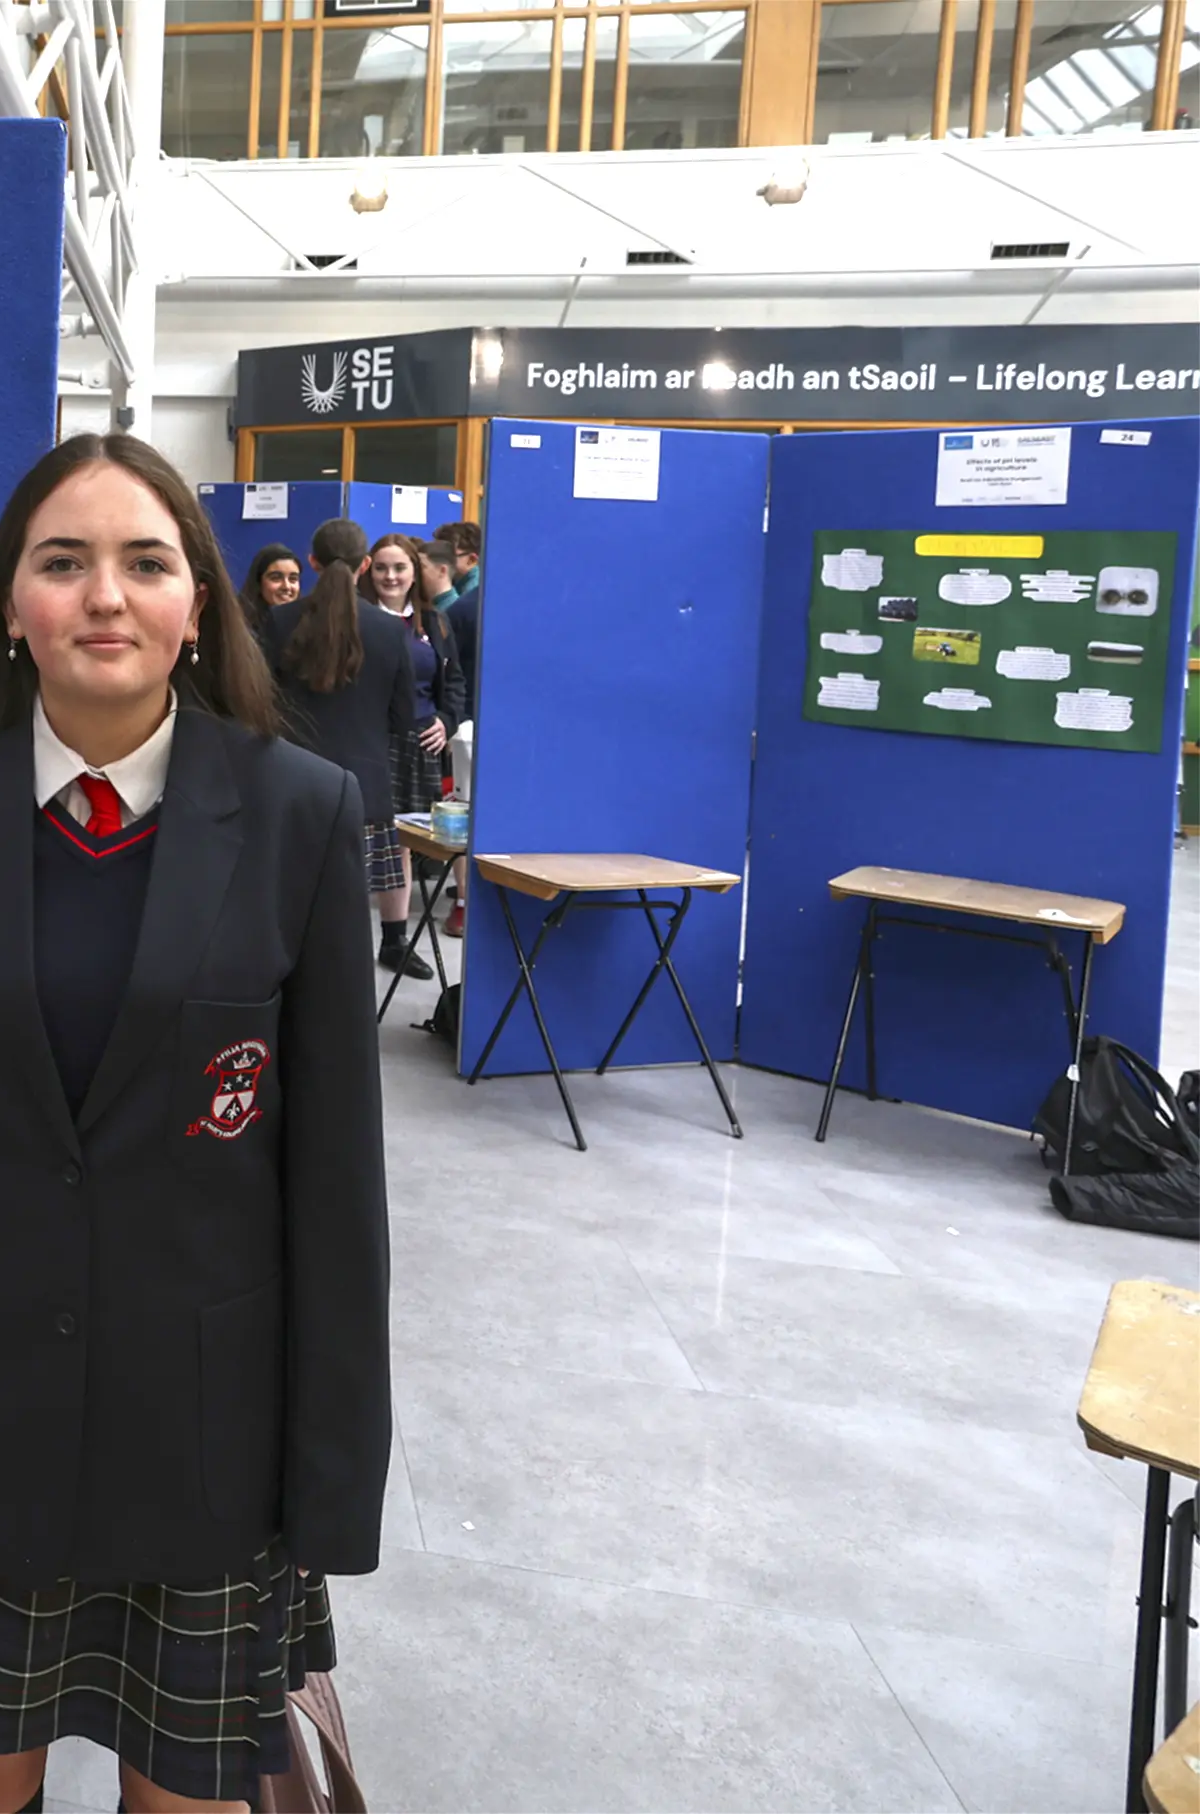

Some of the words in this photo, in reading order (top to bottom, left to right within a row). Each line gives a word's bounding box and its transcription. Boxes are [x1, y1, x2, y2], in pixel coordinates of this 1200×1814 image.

[352, 346, 394, 378] SE
[352, 379, 392, 411] TU
[527, 363, 658, 394] Foghlaim
[664, 368, 696, 389] ar
[802, 369, 840, 390] an
[848, 364, 936, 390] tSaoil
[977, 364, 1108, 397] Lifelong
[1120, 434, 1134, 442] 24
